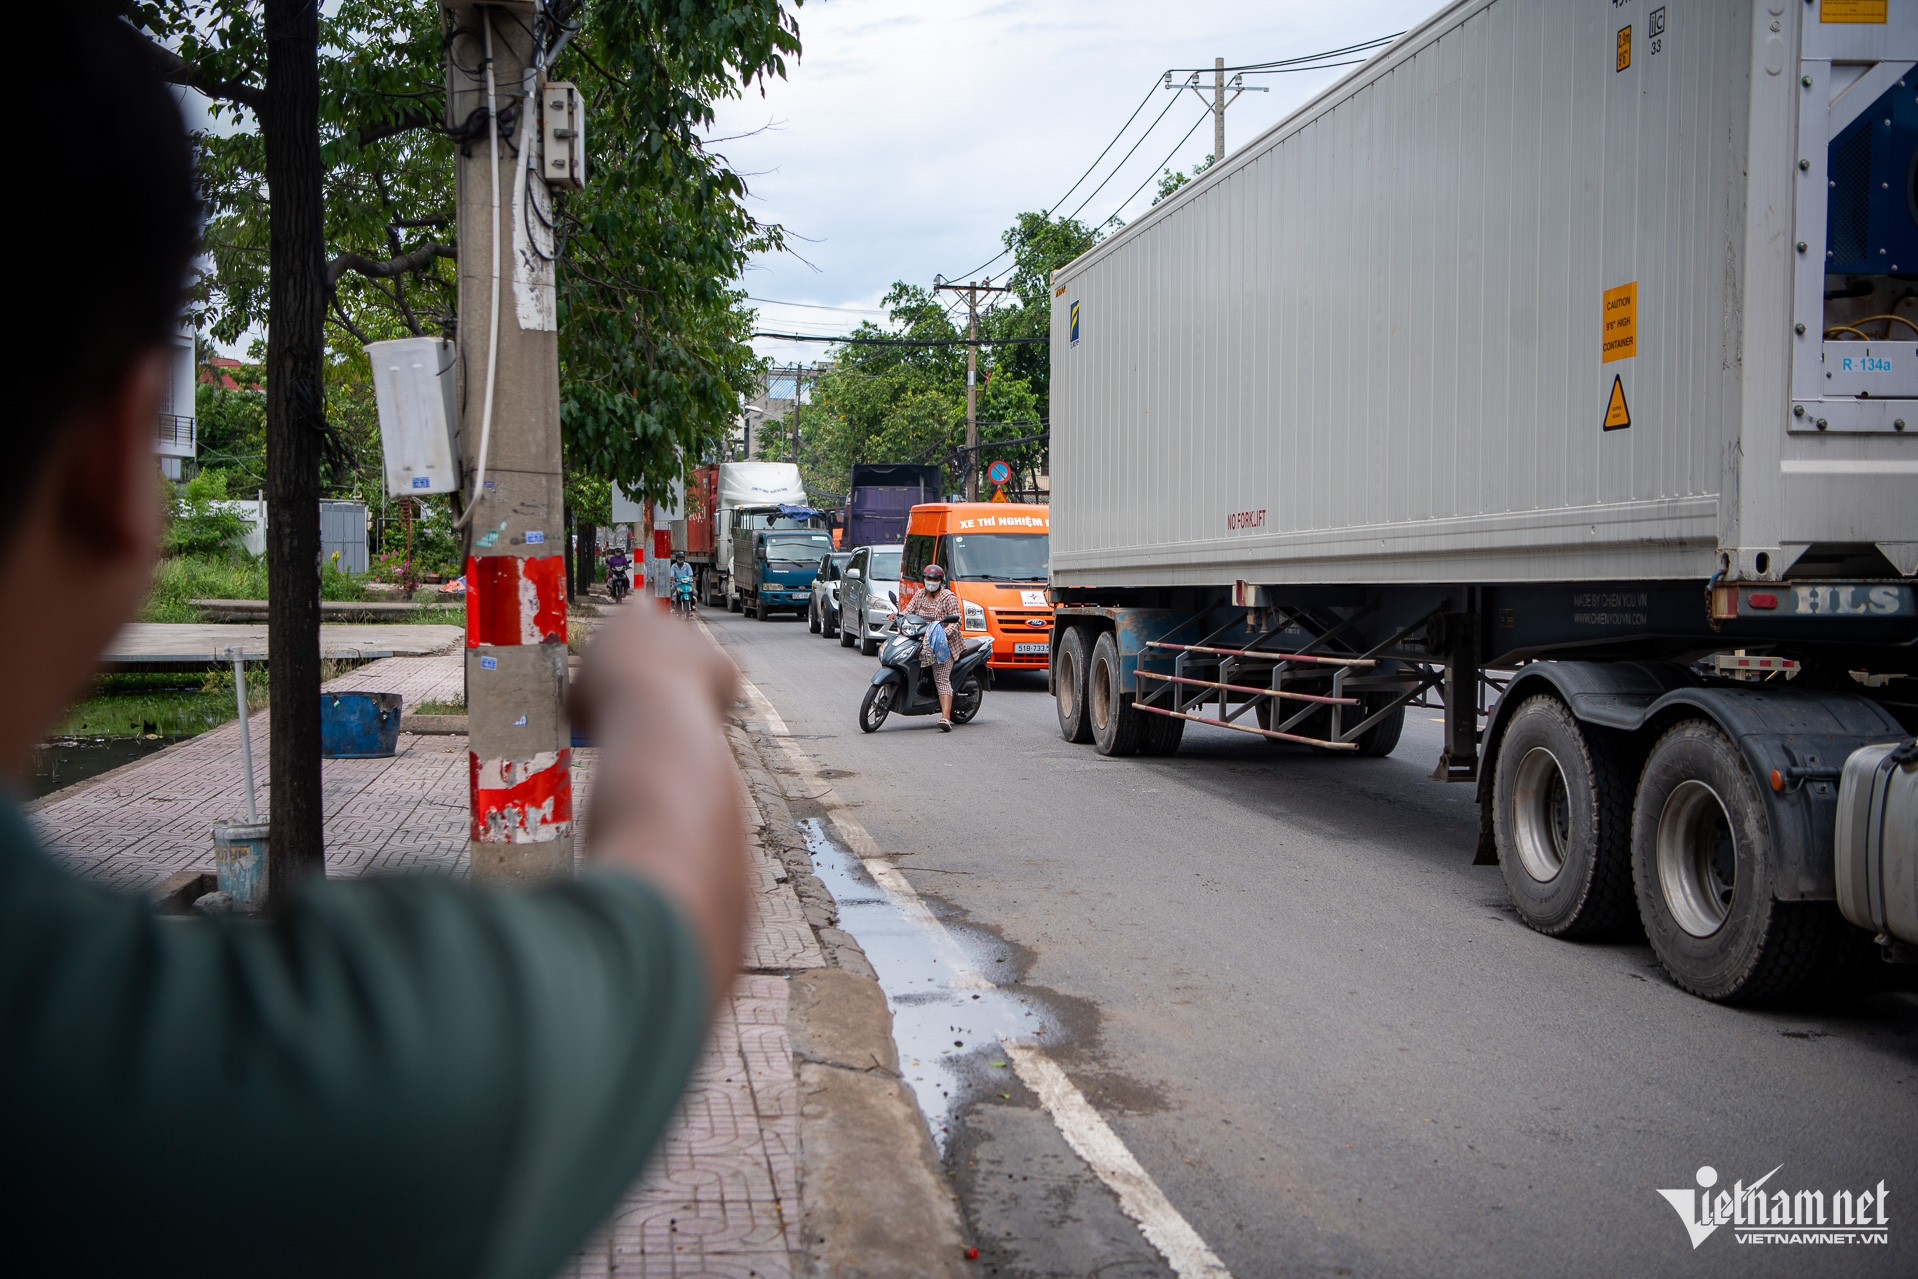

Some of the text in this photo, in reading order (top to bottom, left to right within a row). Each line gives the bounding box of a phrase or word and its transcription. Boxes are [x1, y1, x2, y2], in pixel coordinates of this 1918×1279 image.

[1651, 39, 1661, 55] 33
[1606, 296, 1631, 311] CAUTION
[1617, 317, 1631, 328] HIGH
[1602, 336, 1634, 352] CONTAINER
[960, 519, 975, 529] XE
[977, 515, 995, 527] THÍ
[998, 516, 1043, 528] NGHIỆM
[1227, 509, 1266, 530] NO FORKLIFT
[1573, 593, 1591, 607] MADE
[1592, 593, 1601, 607] BY
[1622, 593, 1636, 607] YOU
[1637, 593, 1647, 607] VN
[1794, 585, 1900, 614] HLS
